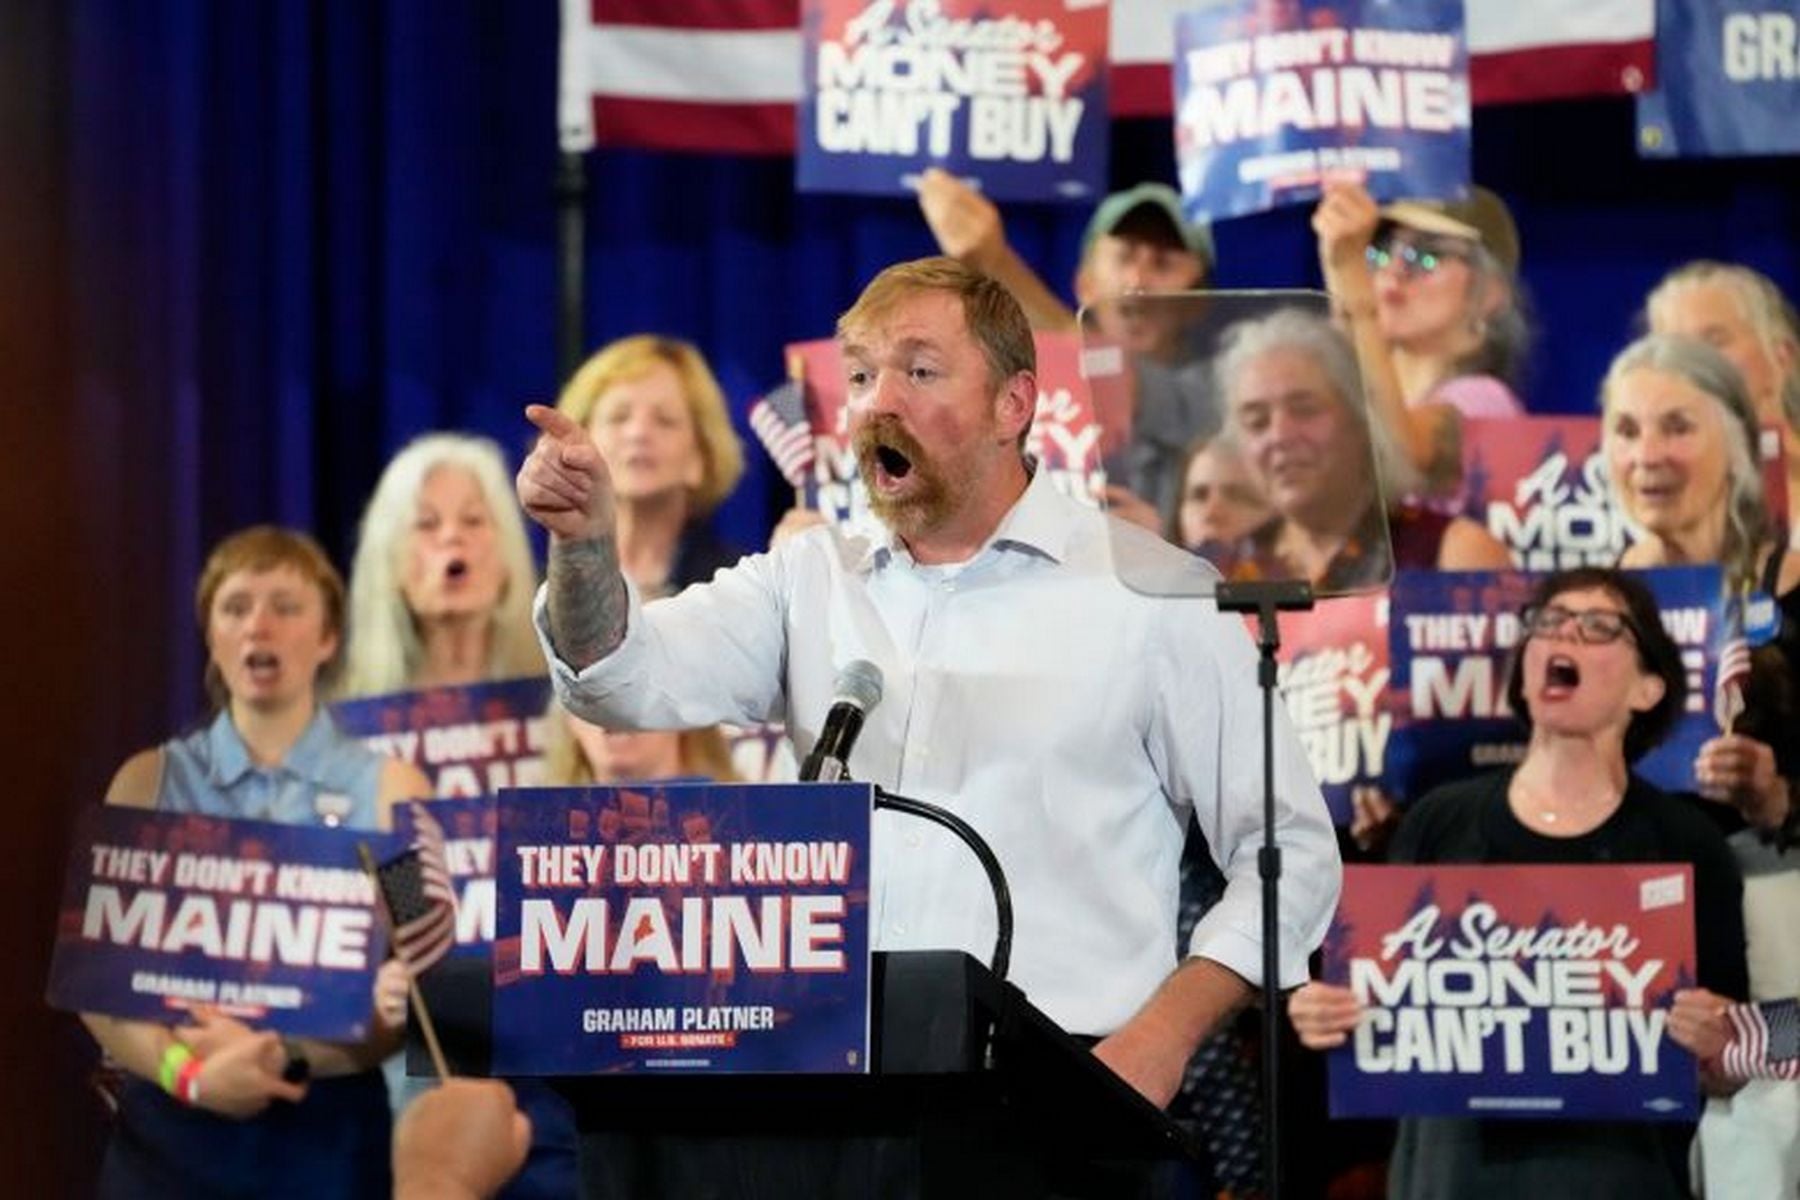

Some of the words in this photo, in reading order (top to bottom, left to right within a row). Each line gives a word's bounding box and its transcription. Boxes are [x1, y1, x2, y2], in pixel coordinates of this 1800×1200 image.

[816, 41, 1084, 98] MONEY
[1723, 12, 1800, 82] GR
[816, 90, 961, 157] CAN'T
[968, 97, 1084, 162] BUY
[1181, 66, 1456, 148] MAINE
[1405, 614, 1487, 649] THEY
[91, 845, 170, 888] THEY
[174, 852, 276, 896] DON'T
[516, 844, 606, 888] THEY
[614, 842, 722, 887] DON'T
[730, 840, 848, 885] KNOW
[81, 884, 373, 970] MAINE
[521, 894, 845, 973] MAINE
[1381, 903, 1444, 962] A
[1450, 902, 1640, 960] Senator
[1350, 958, 1665, 1008] MONEY
[583, 1007, 676, 1033] GRAHAM
[682, 1006, 775, 1031] PLATNER
[1355, 1006, 1532, 1075] CAN'T
[1549, 1007, 1668, 1076] BUY
